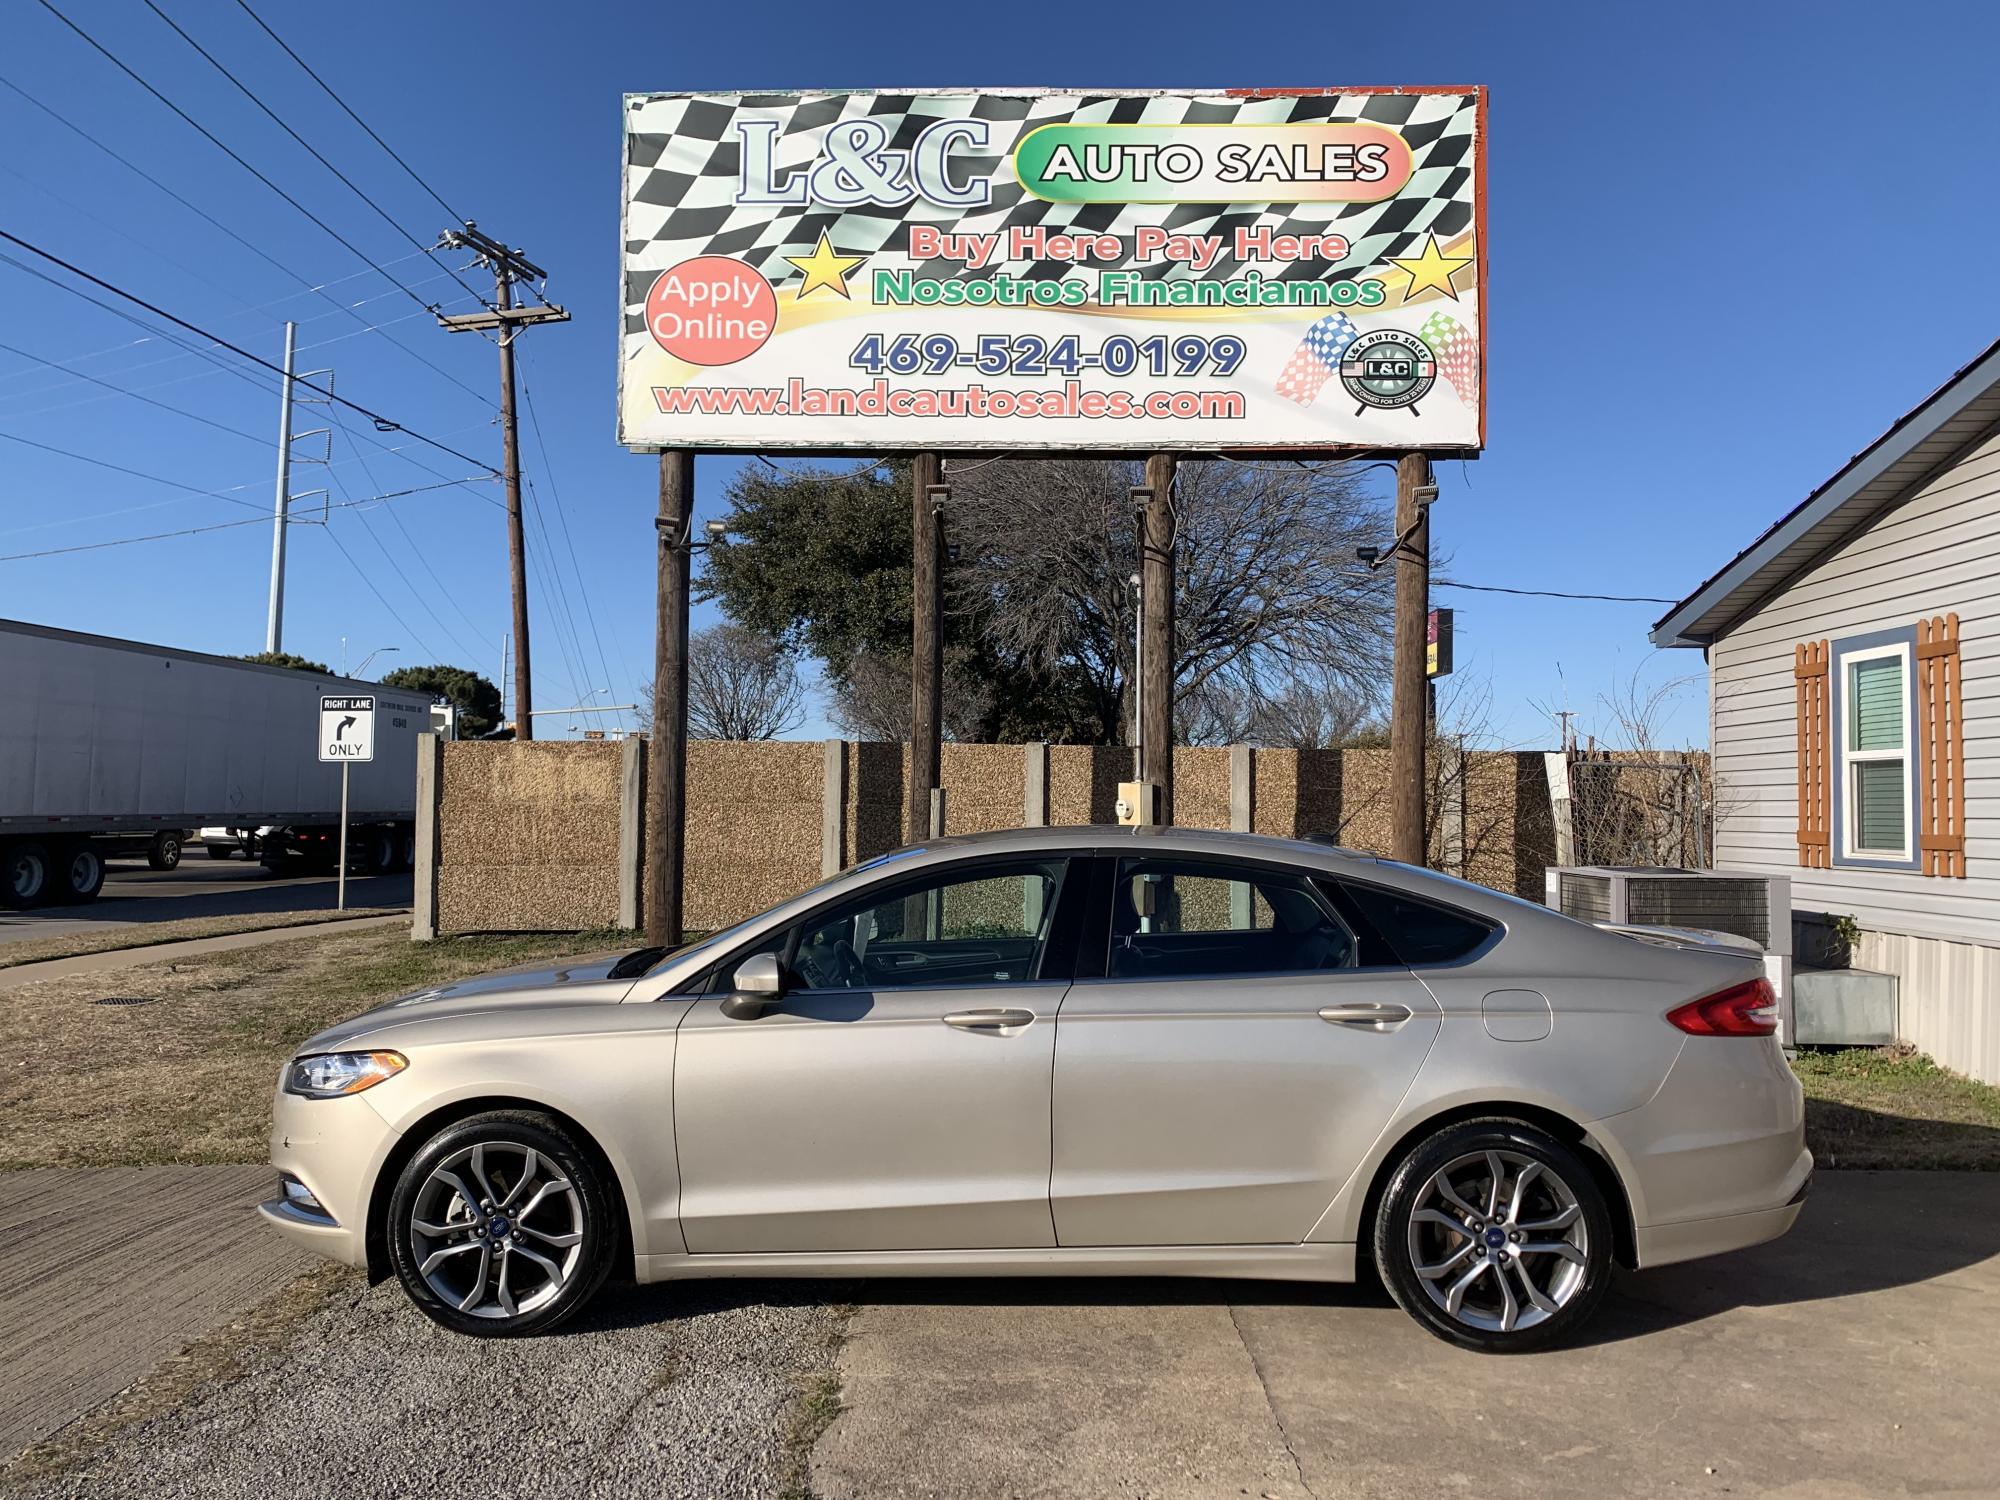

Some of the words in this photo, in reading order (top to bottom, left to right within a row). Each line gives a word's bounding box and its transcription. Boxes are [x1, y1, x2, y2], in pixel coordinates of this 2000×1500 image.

[735, 120, 991, 206] L&C
[1039, 143, 1203, 183] AUTO
[1216, 143, 1389, 183] SALES
[908, 225, 1001, 269] Buy
[1008, 225, 1123, 262] Here
[1134, 226, 1221, 271] Pay
[1234, 226, 1350, 262] Here
[660, 275, 761, 309] Apply
[872, 269, 1087, 306] Nosotros
[1099, 270, 1387, 307] Financiamos
[652, 311, 768, 340] Online
[849, 333, 1247, 377] 469-524-0199
[1348, 342, 1365, 359] L&C
[1368, 334, 1398, 343] AUTO
[1403, 338, 1428, 359] SALES
[1368, 362, 1408, 376] L&C
[651, 377, 1246, 419] www.landcautosales.com
[1359, 391, 1380, 403] OWNED
[1394, 395, 1410, 404] OVER
[1415, 378, 1429, 393] YEARS
[324, 700, 347, 709] RIGHT
[351, 700, 371, 709] LANE
[329, 744, 363, 756] ONLY
